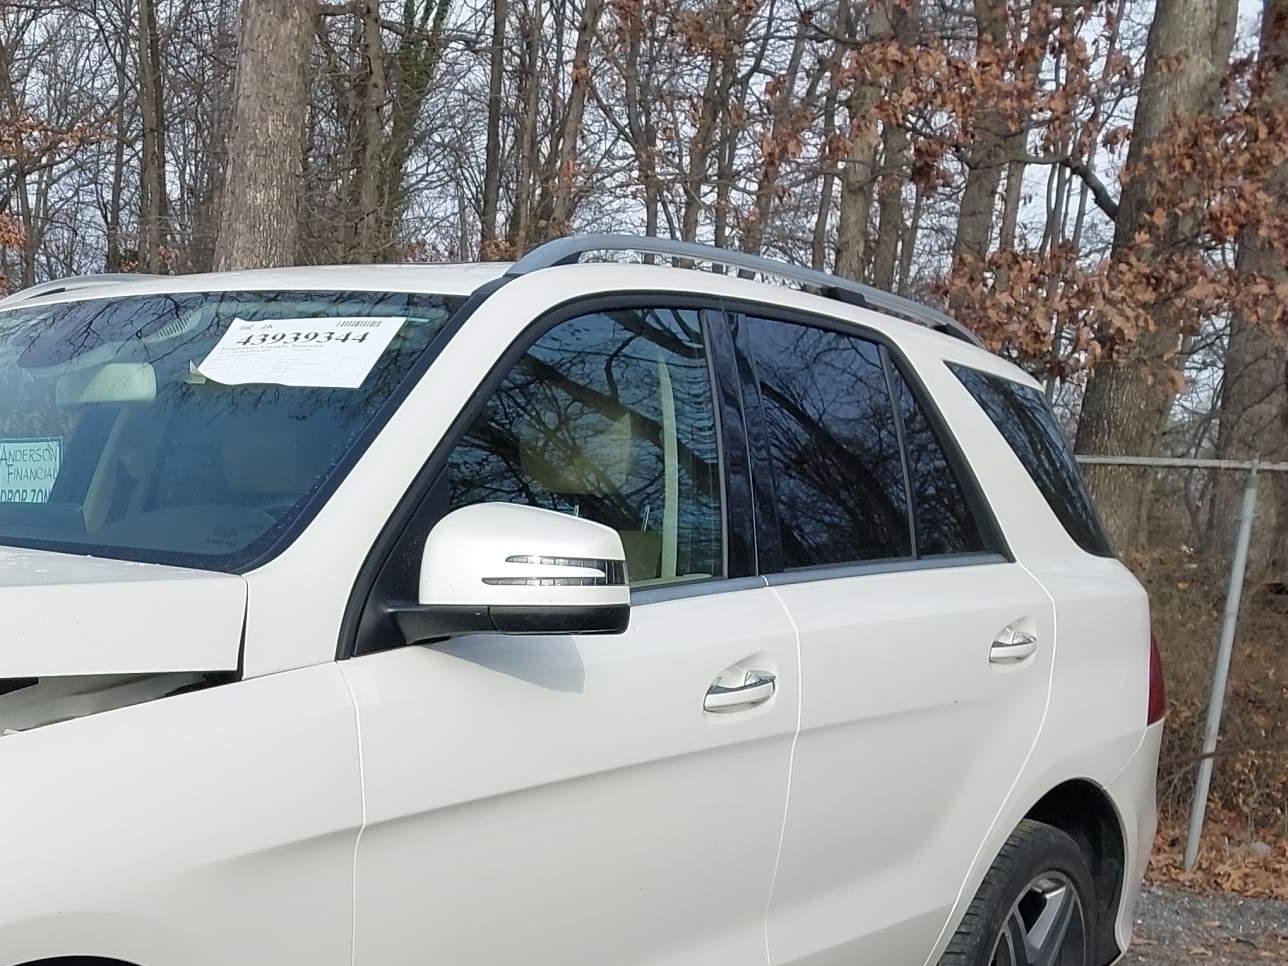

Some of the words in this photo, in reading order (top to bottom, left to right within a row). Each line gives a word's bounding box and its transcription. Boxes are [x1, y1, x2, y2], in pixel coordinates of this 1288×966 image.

[237, 331, 370, 346] 43939344
[0, 444, 58, 466] ANDERSON
[7, 464, 58, 483] FINANCIAL
